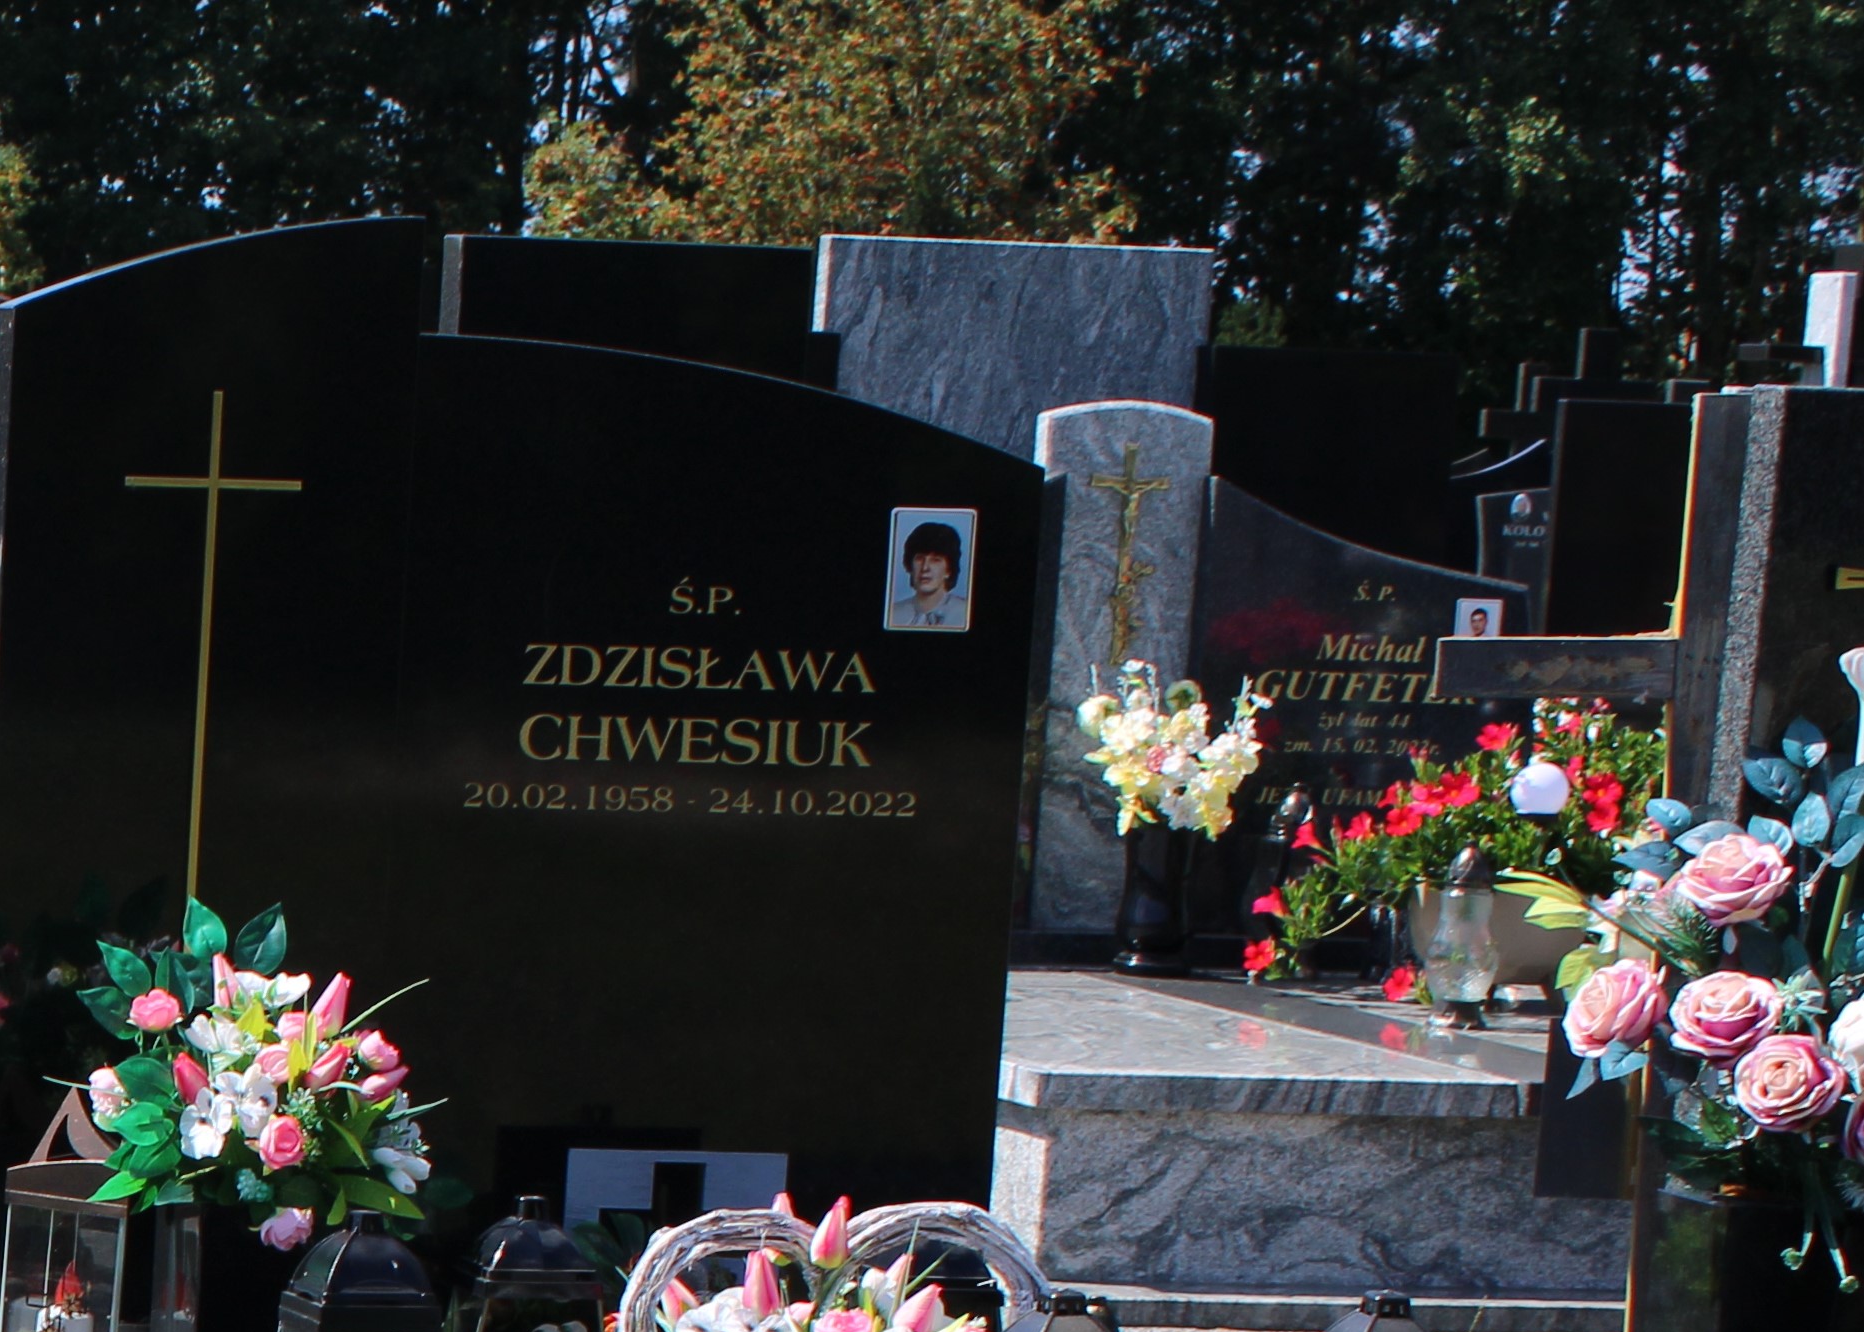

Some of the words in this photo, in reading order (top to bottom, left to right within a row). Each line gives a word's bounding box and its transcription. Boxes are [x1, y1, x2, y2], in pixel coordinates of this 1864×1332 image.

[669, 577, 742, 615] Ś.P.
[522, 643, 877, 693] ZDZISŁAWA
[519, 713, 872, 768] CHWESIUK
[462, 782, 674, 812] 20.02.1958
[708, 787, 918, 818] 24.10.2022
